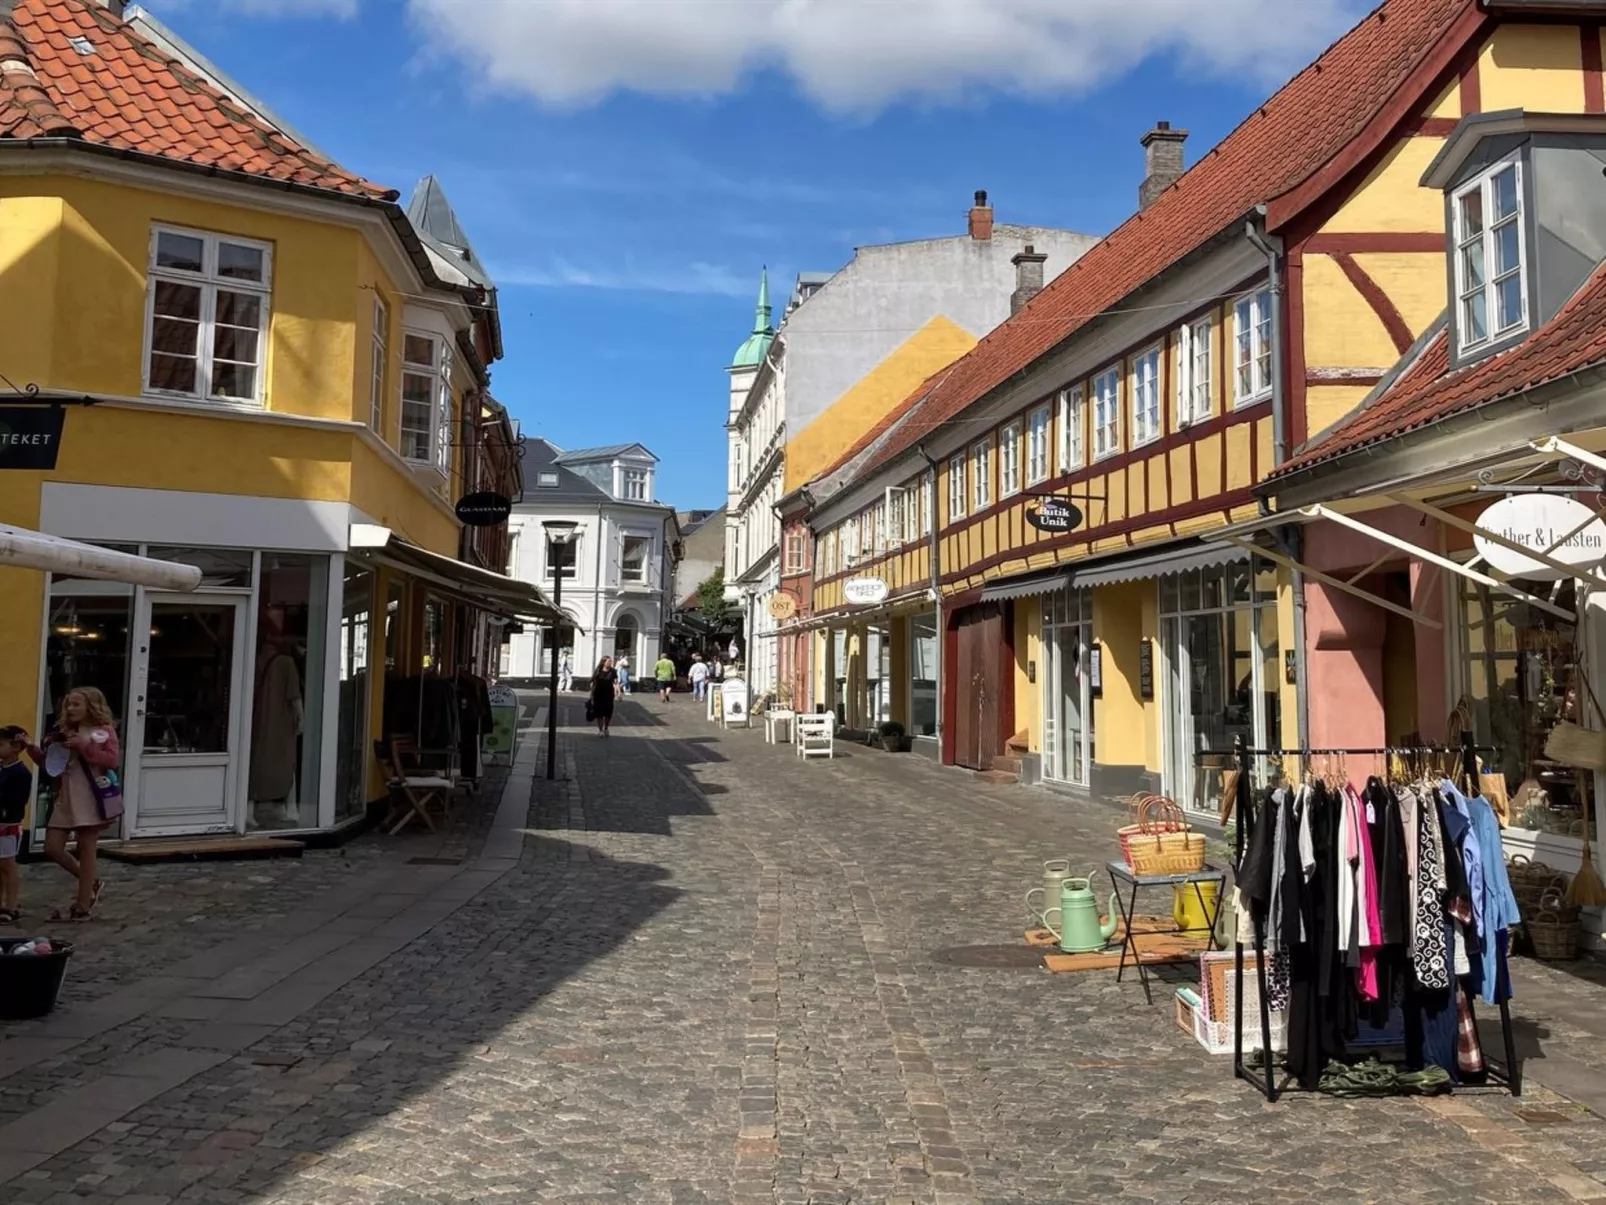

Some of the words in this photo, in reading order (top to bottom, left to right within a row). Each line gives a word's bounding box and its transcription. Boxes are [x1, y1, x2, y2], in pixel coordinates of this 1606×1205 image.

[1, 433, 51, 445] TEKET
[1039, 507, 1070, 517] Butik
[1040, 516, 1068, 526] Unik
[1482, 526, 1531, 546] ther
[1535, 527, 1546, 546] &
[772, 601, 790, 610] OST
